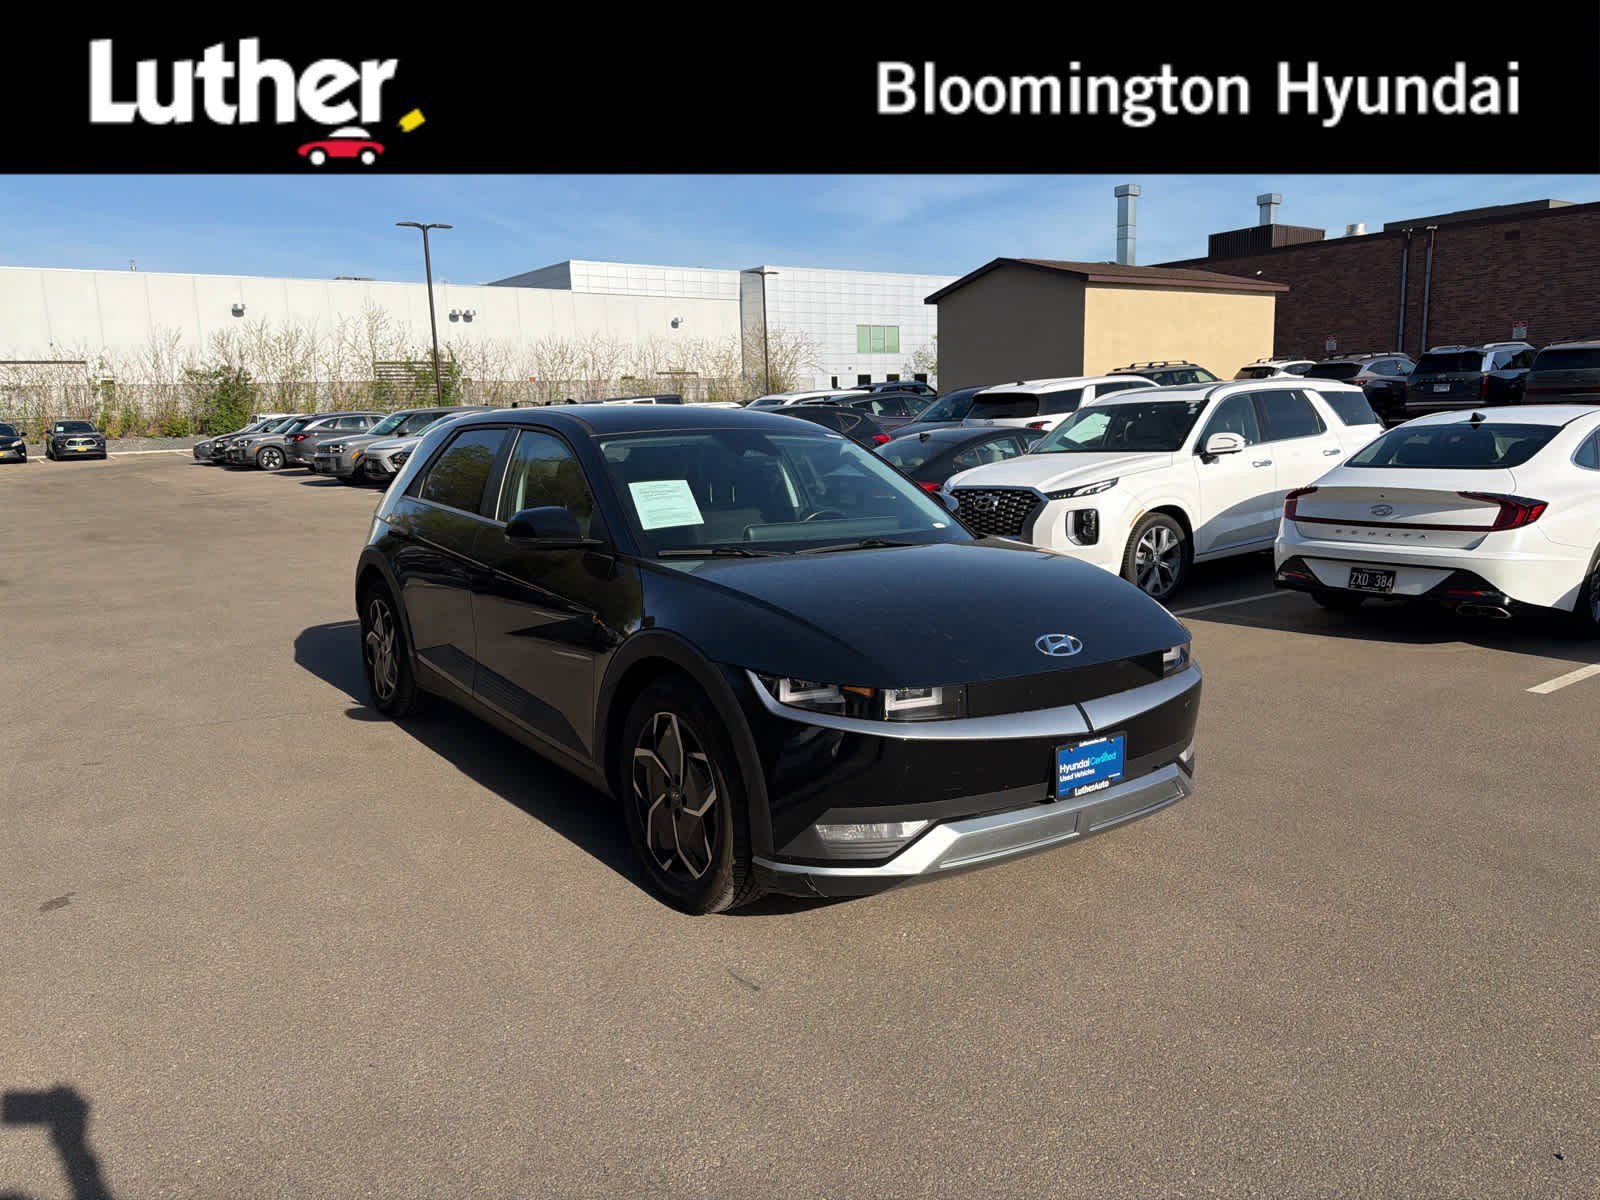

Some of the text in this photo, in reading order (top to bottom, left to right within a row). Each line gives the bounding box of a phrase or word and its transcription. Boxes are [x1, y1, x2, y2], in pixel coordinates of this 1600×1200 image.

[1059, 751, 1116, 773] Hyundai Certified
[1059, 768, 1095, 782] Used Vehicles
[1075, 780, 1109, 796] LutherAuto
